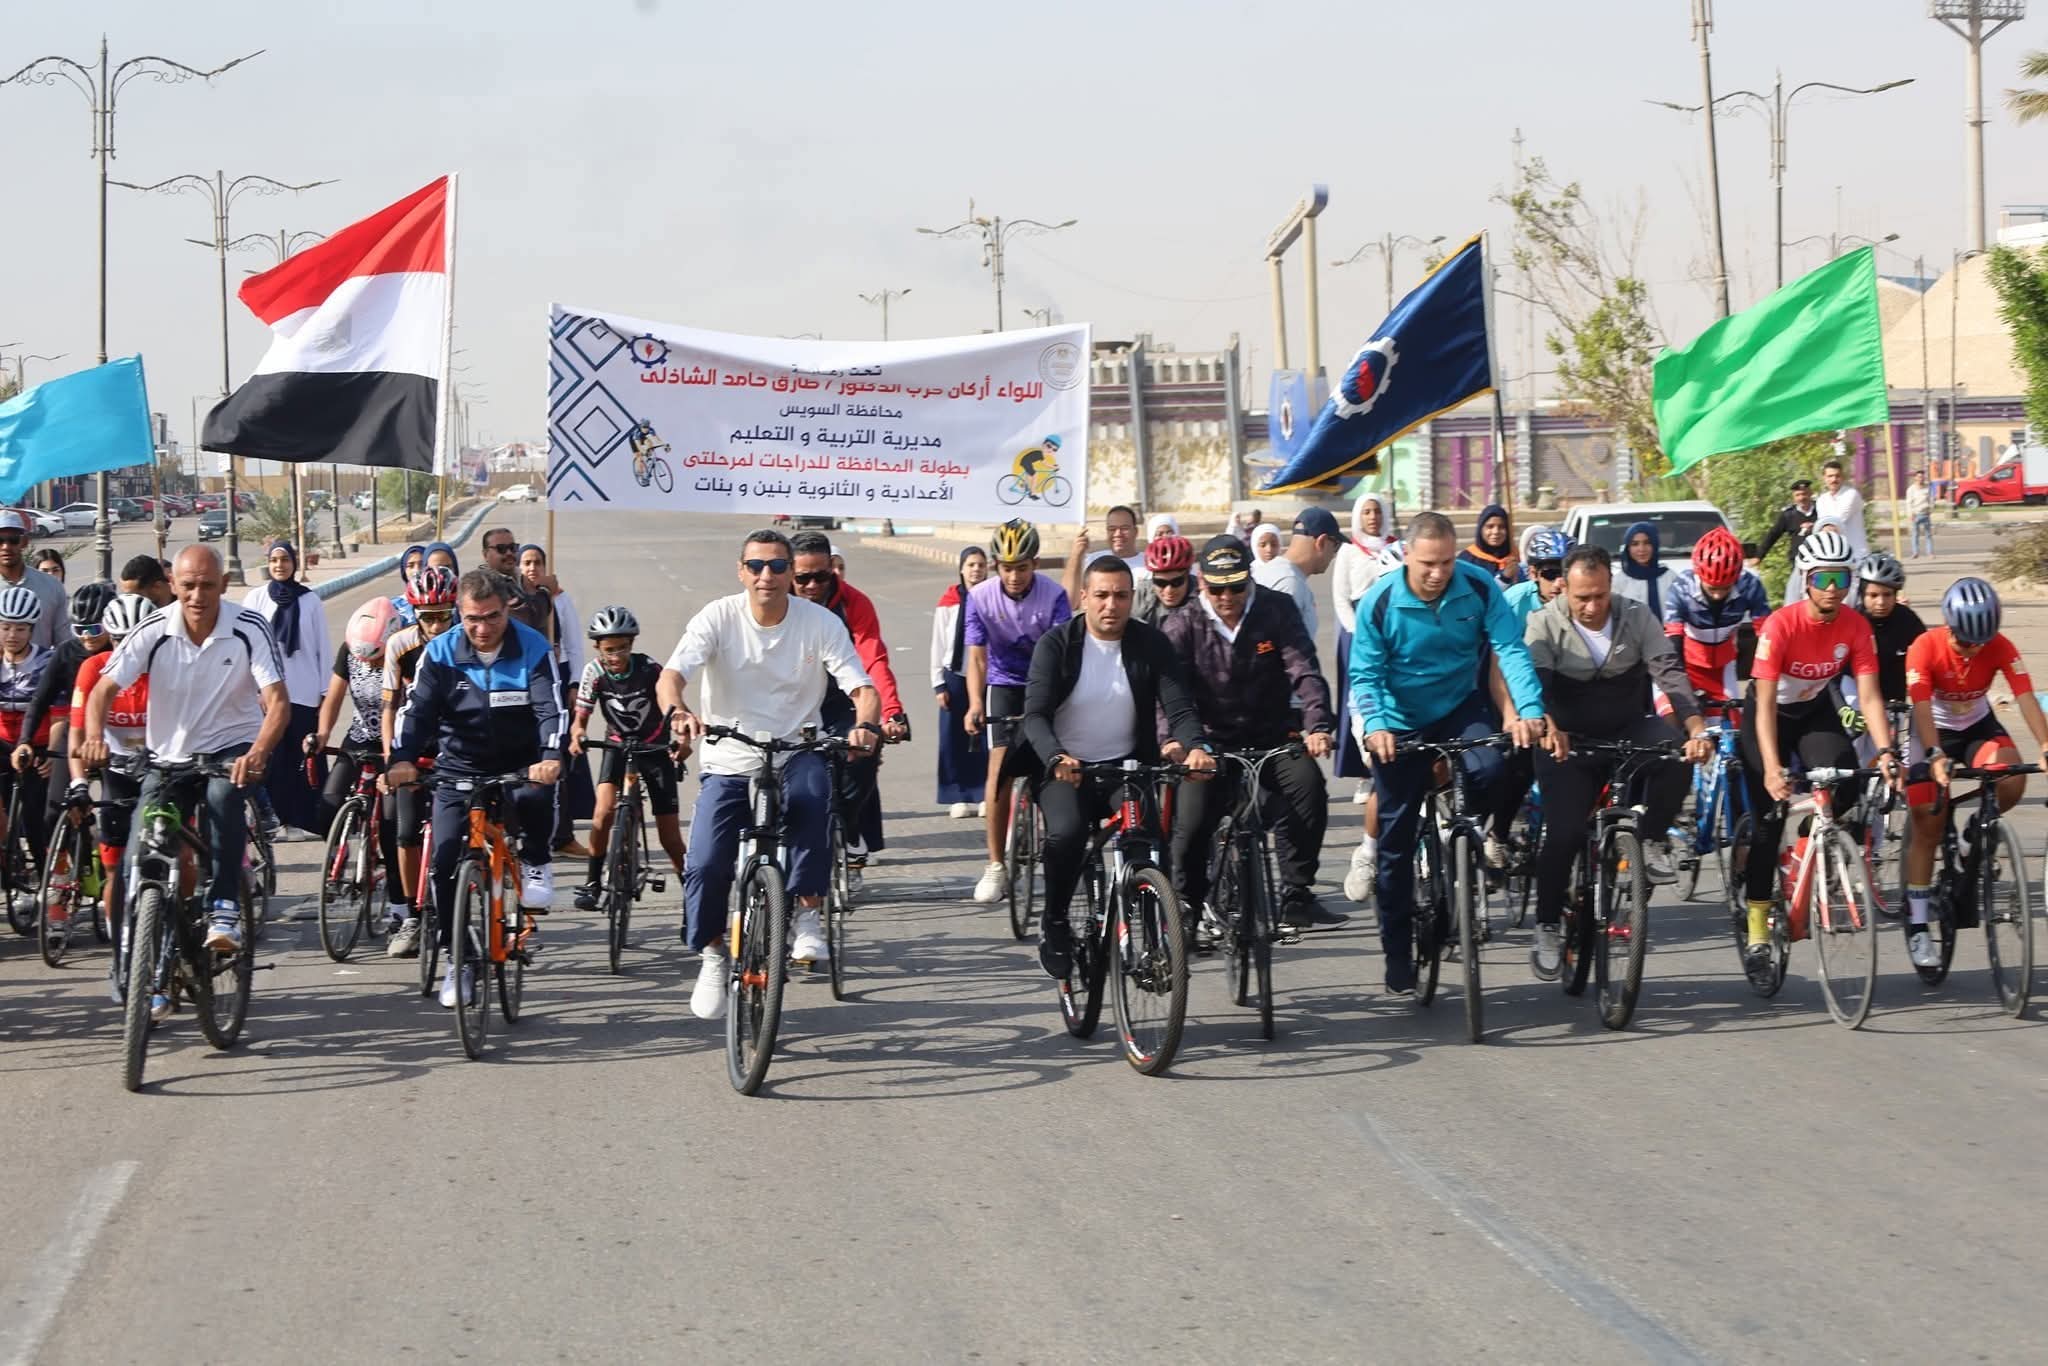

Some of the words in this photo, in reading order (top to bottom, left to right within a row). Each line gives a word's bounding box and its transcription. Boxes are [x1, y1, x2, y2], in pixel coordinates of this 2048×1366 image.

[791, 364, 844, 377] رعة
[849, 365, 882, 376] تحت
[722, 372, 767, 388] حامد
[771, 377, 820, 393] طارق
[948, 375, 990, 401] أركان
[997, 382, 1043, 402] اللواء
[779, 404, 839, 418] السويس
[846, 405, 902, 420] محافظة
[730, 426, 793, 445] التعليم
[800, 432, 810, 446] و
[816, 429, 875, 449] التربية
[882, 432, 941, 450] مديرية
[758, 455, 830, 473] للدراجات
[836, 457, 913, 473] المحافظة
[919, 461, 970, 479] بطولة
[694, 478, 733, 497] بنات
[738, 484, 747, 497] و
[753, 481, 791, 499] بنين
[797, 480, 859, 499] الثانوية
[865, 488, 875, 502] و
[881, 481, 953, 503] الأعدادية
[1789, 661, 1842, 677] EGYPT
